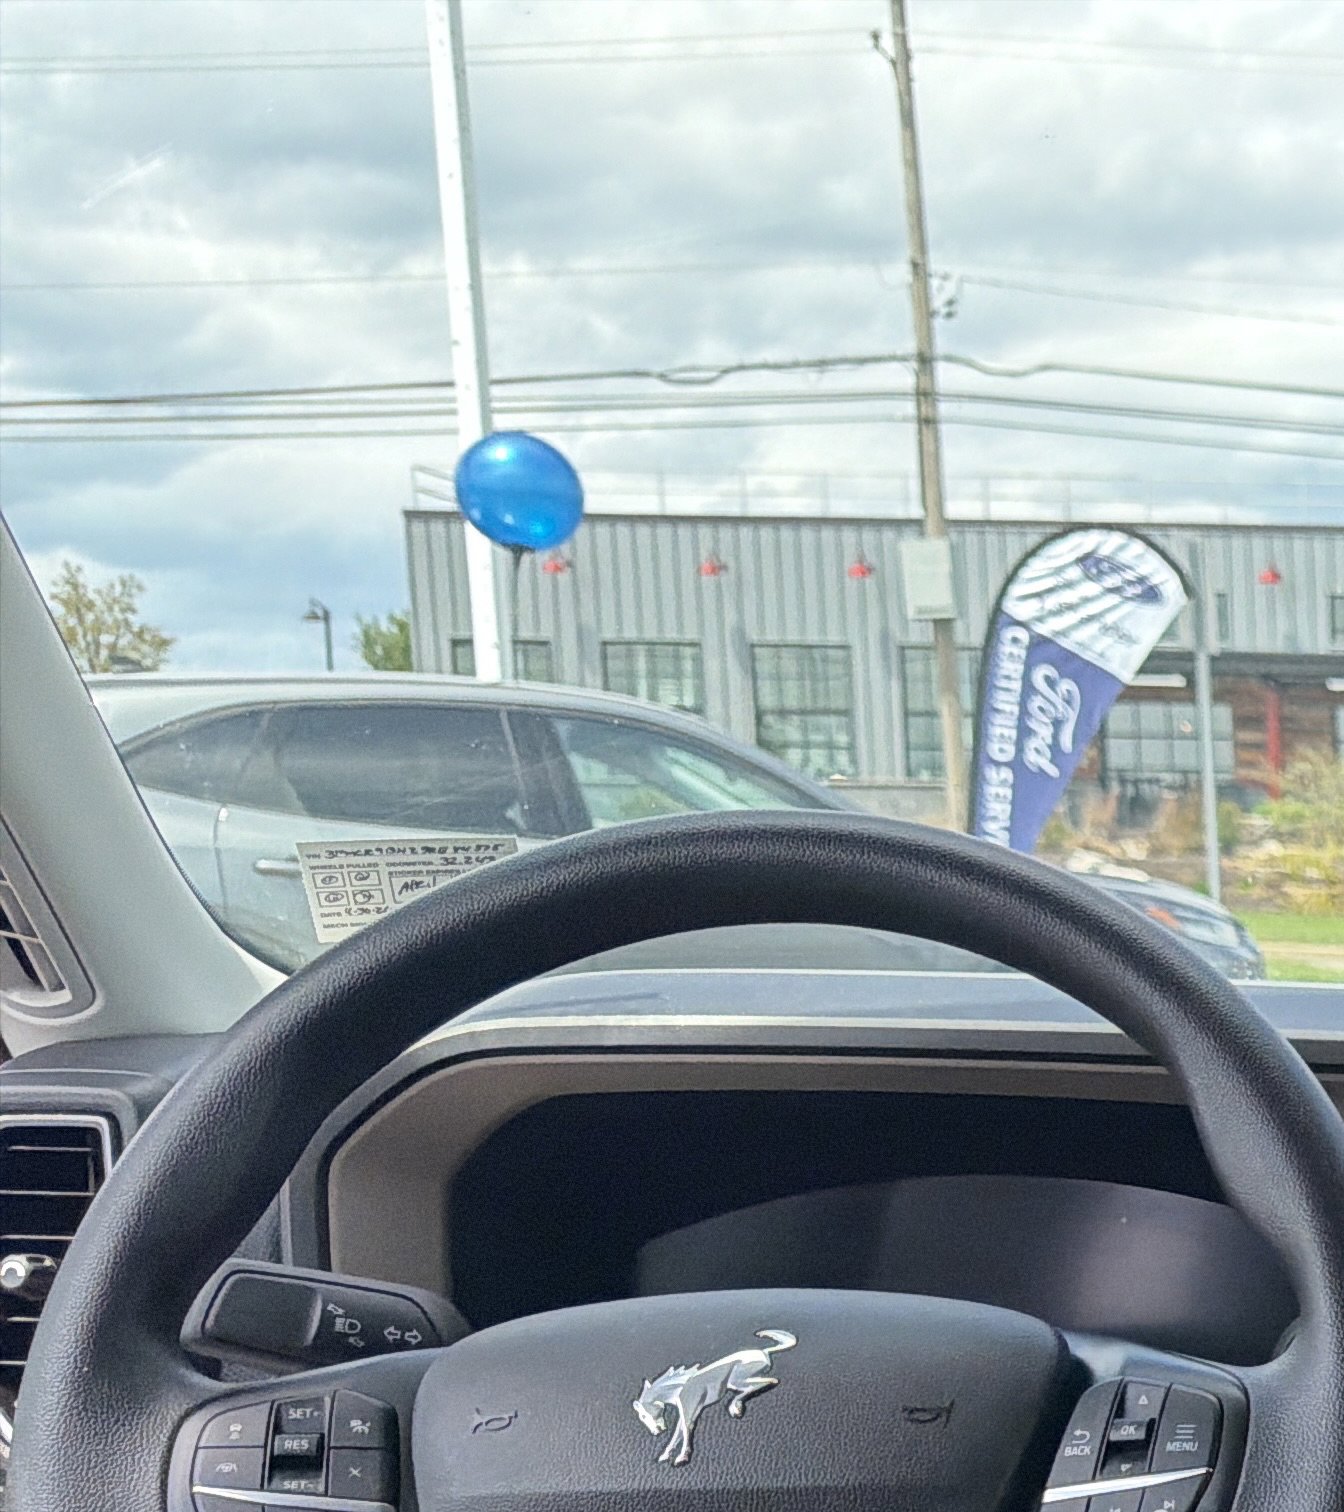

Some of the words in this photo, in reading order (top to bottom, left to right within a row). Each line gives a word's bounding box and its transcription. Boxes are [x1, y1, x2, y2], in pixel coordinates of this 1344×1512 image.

[986, 624, 1030, 763] CERTIFIED
[1023, 663, 1081, 778] Ford
[976, 763, 1015, 847] SERVI
[1120, 1425, 1138, 1435] OK
[284, 1440, 309, 1450] RES
[1064, 1445, 1091, 1457] BACK
[1166, 1441, 1198, 1452] MENU
